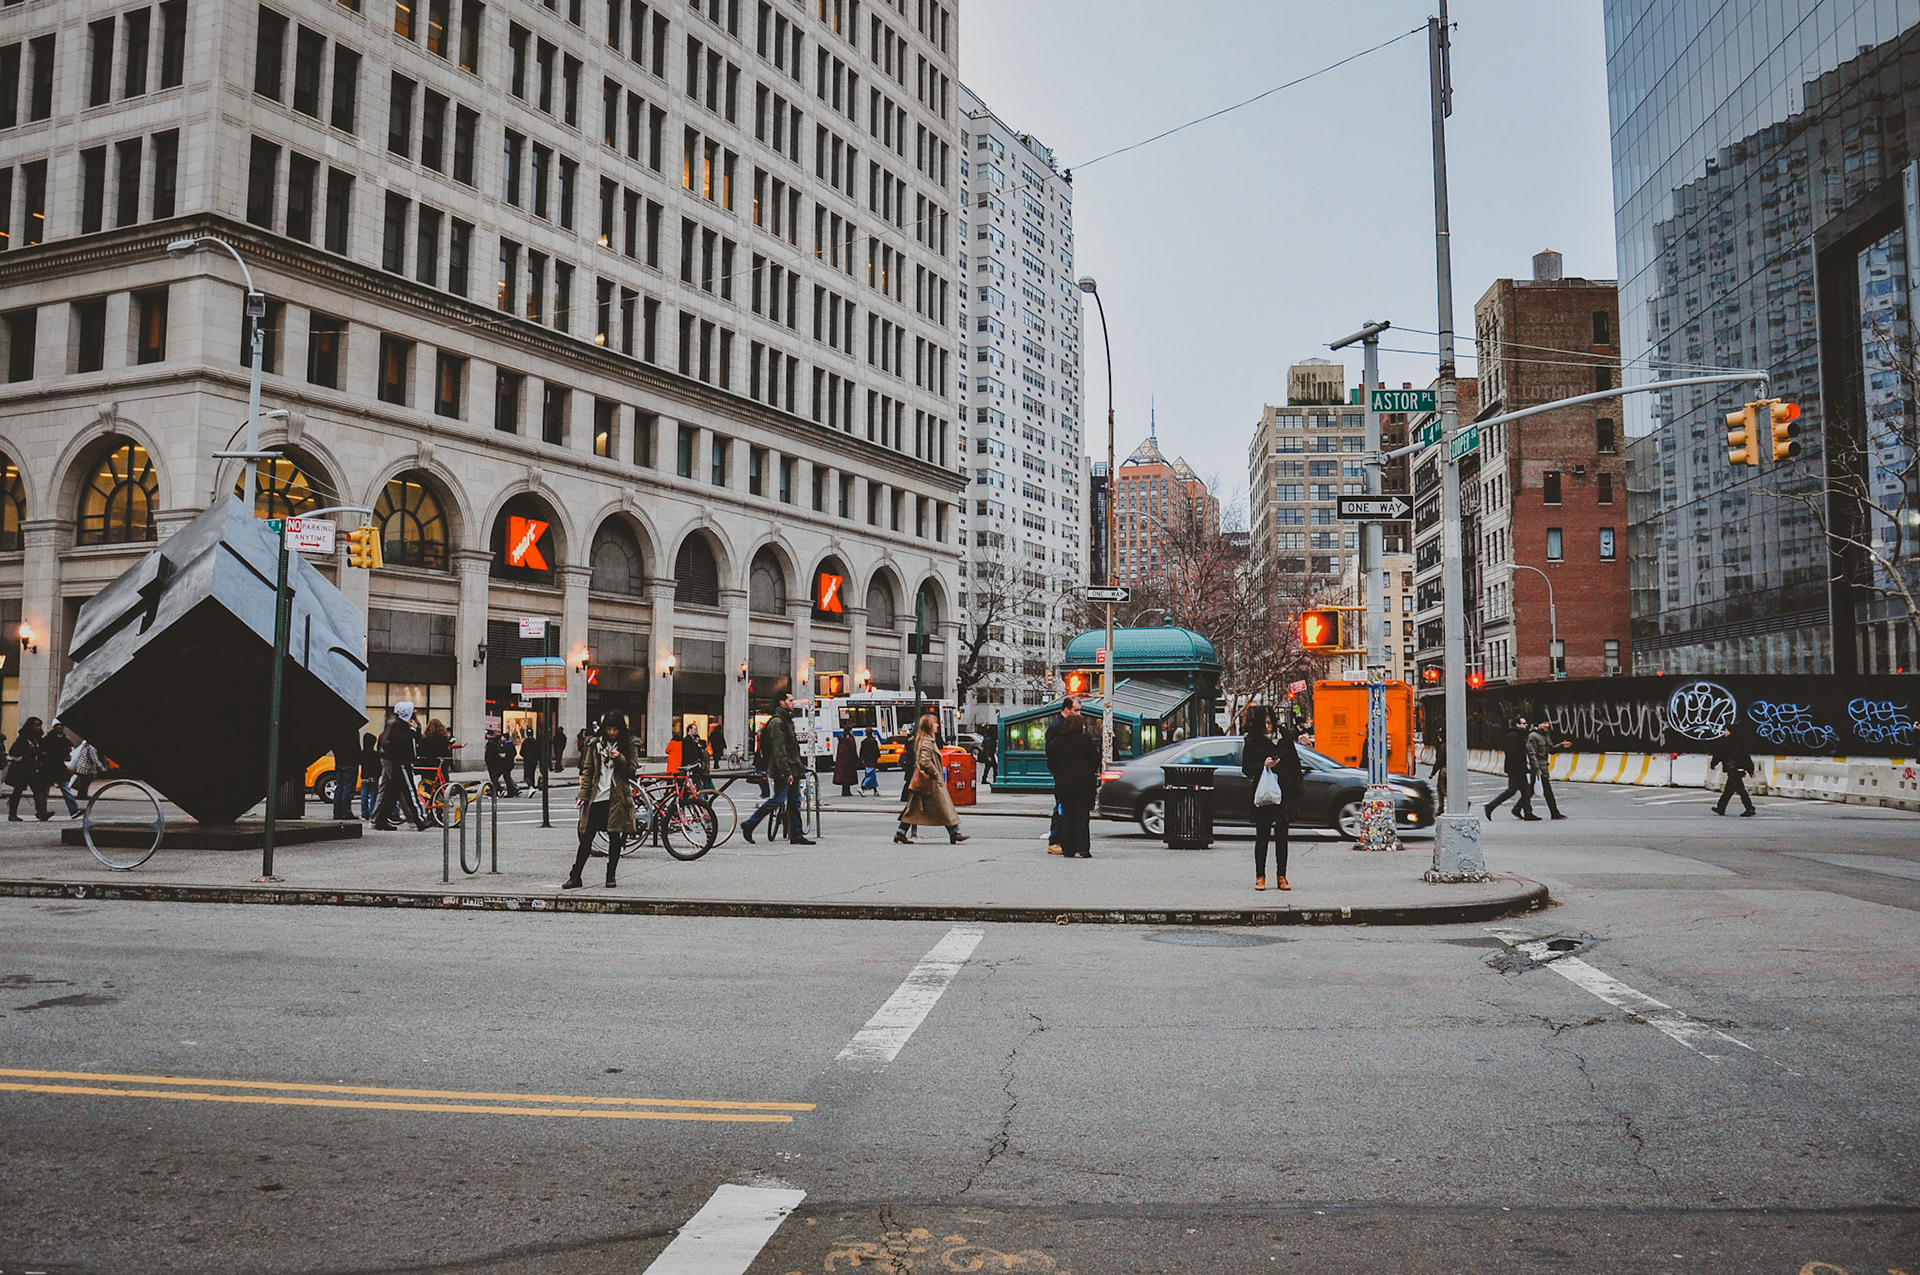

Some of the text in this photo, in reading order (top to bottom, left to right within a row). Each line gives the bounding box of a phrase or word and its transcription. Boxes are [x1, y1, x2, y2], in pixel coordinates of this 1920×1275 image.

[1374, 392, 1433, 410] ASTOR PL
[1429, 425, 1434, 443] 4
[1452, 432, 1470, 458] COOPER
[1348, 503, 1402, 513] ONE WAY
[288, 519, 301, 531] NO
[302, 523, 333, 533] PARKING
[294, 534, 327, 543] ANYTIME
